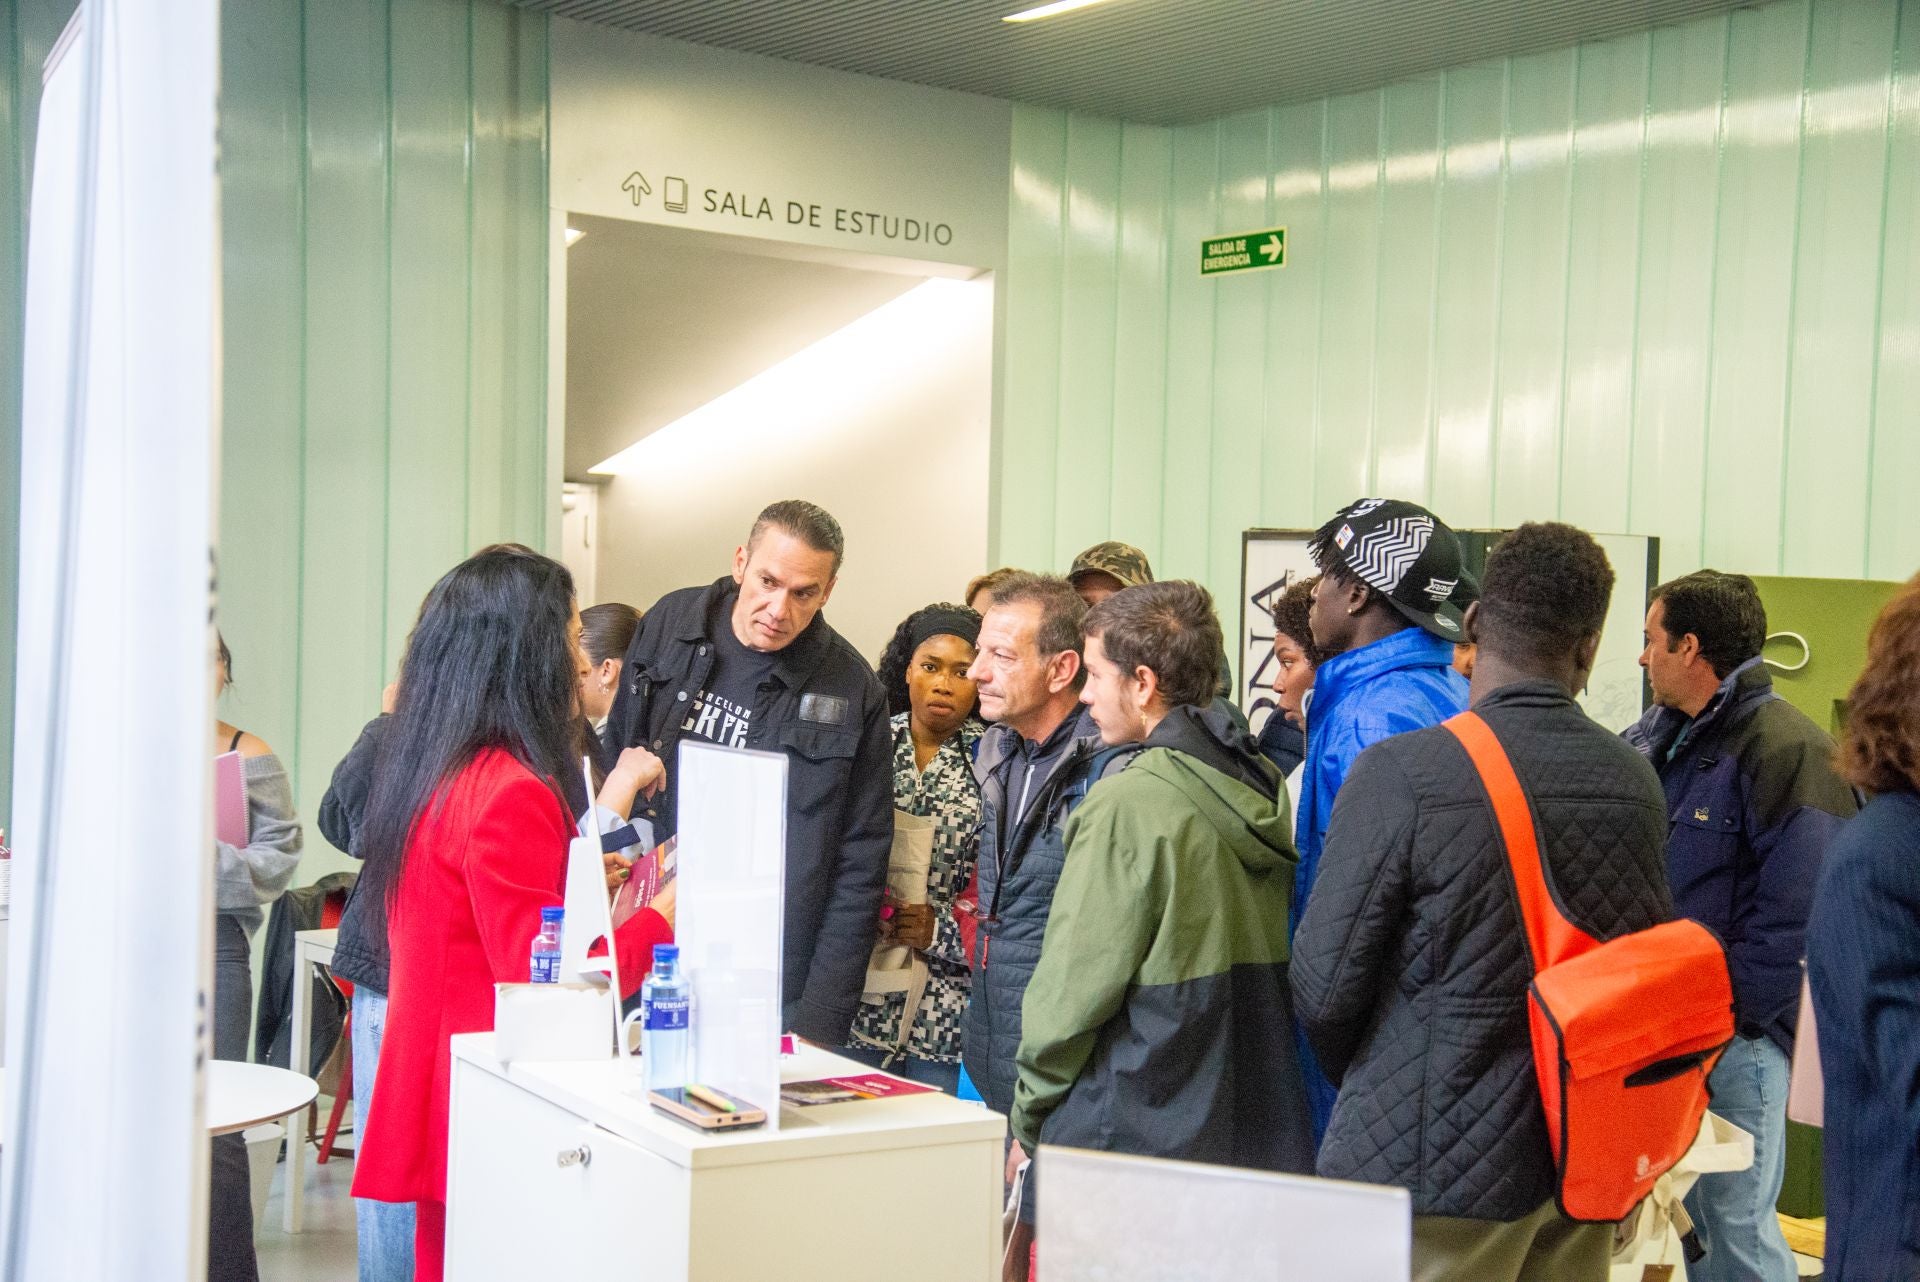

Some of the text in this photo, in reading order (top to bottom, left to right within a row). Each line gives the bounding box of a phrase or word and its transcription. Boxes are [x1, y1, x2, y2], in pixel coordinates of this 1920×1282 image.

[704, 189, 953, 246] SALA DE ESTUDIO
[1209, 240, 1246, 256] SALIDA DE
[1204, 253, 1251, 270] EMERGENCIA
